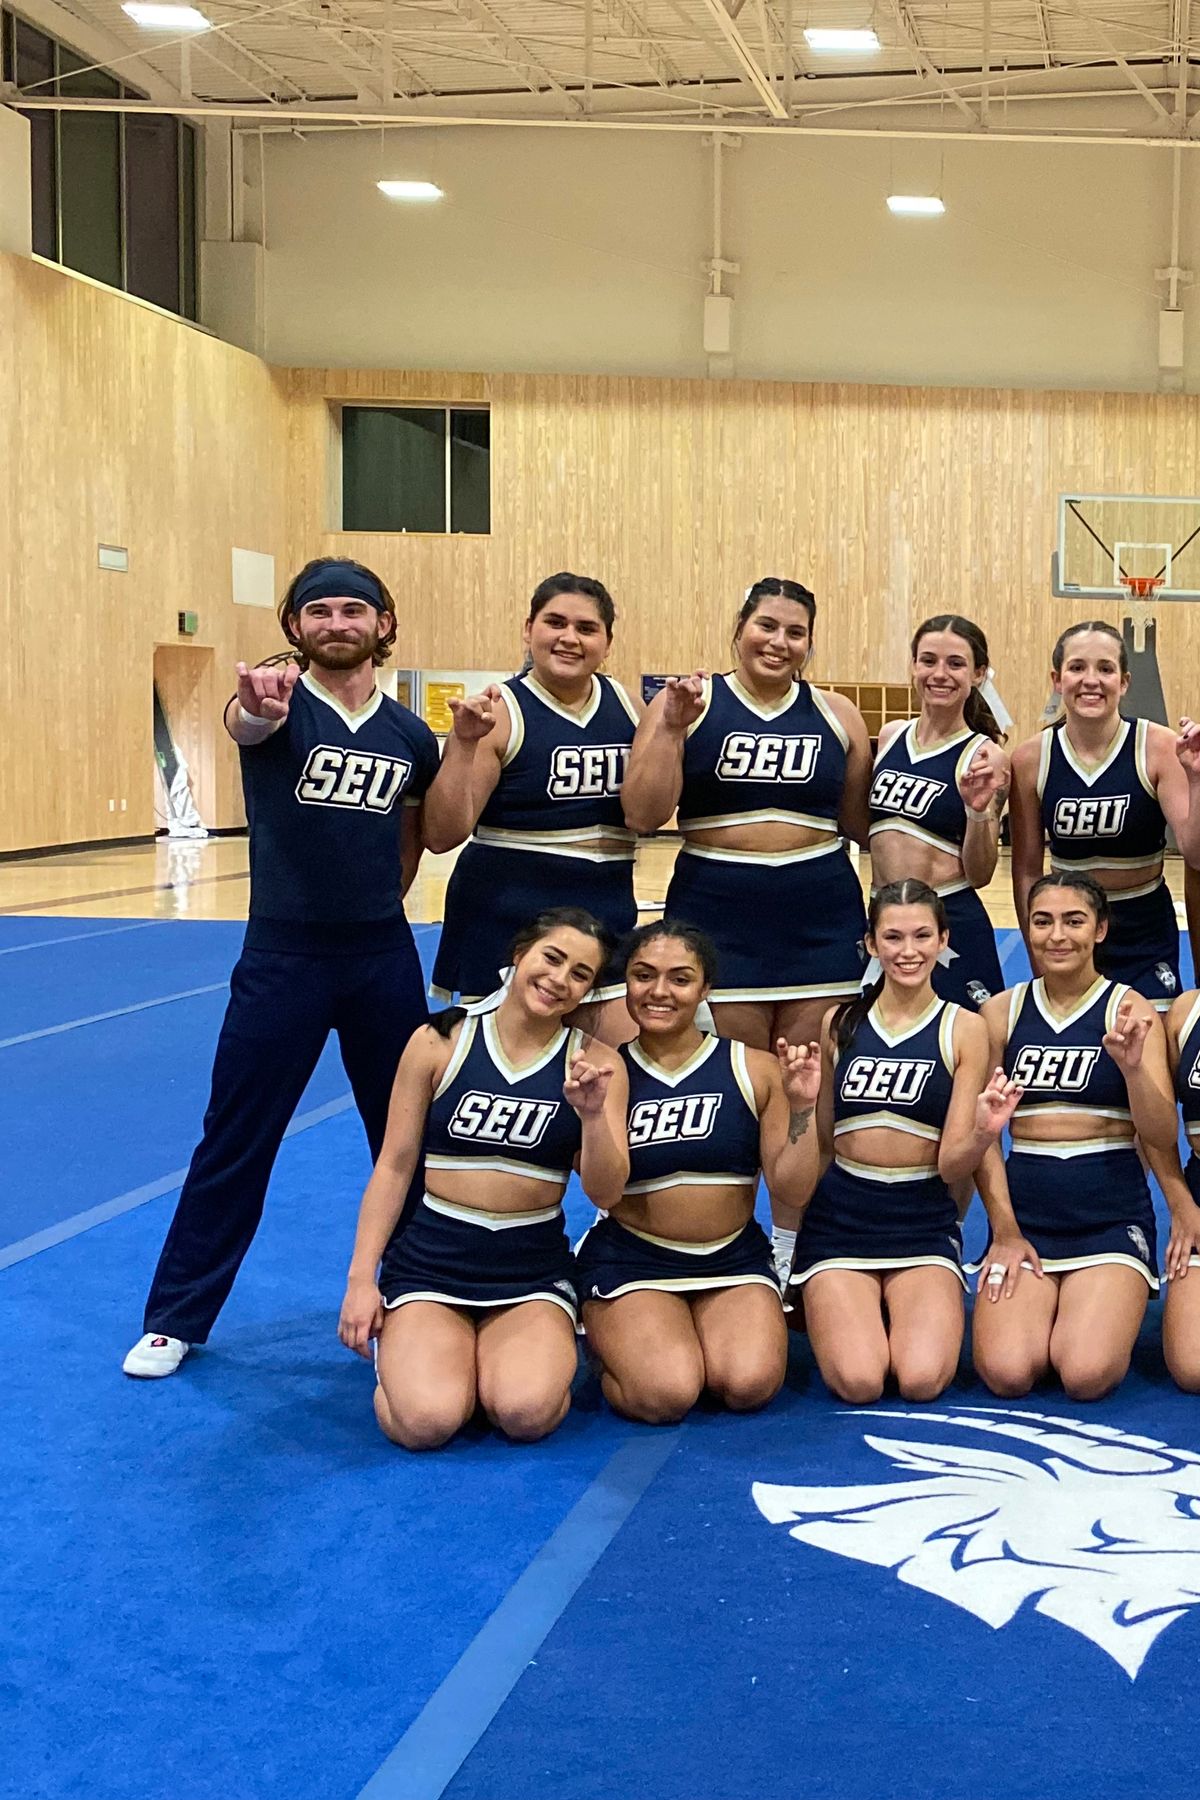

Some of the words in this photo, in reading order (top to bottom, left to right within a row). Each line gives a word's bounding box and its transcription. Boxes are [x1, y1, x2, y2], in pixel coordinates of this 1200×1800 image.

[296, 744, 412, 814] SEU
[547, 744, 632, 800] SEU
[716, 732, 821, 783] SEU
[871, 769, 946, 818] SEU
[1055, 794, 1130, 838] SEU
[841, 1056, 935, 1105] SEU
[1014, 1045, 1102, 1092] SEU
[450, 1091, 559, 1149] SEU
[628, 1093, 723, 1149] SEU
